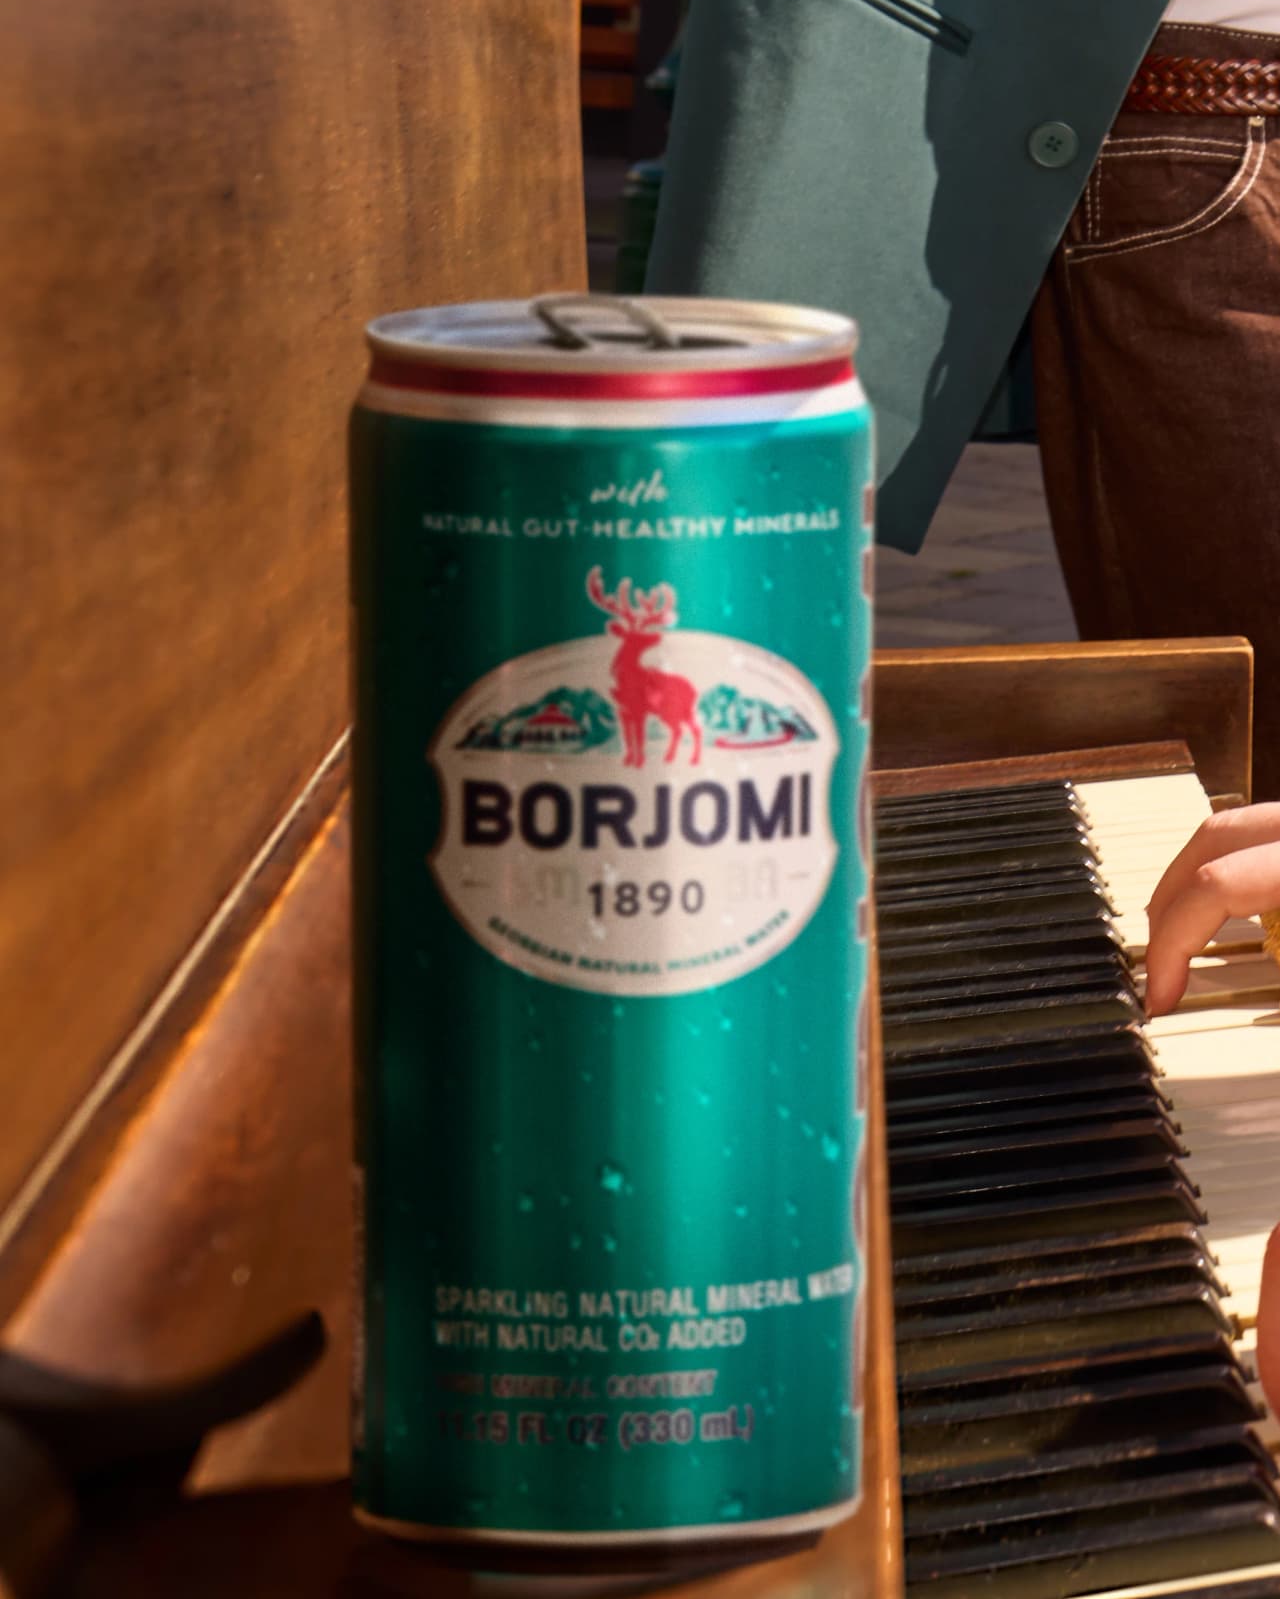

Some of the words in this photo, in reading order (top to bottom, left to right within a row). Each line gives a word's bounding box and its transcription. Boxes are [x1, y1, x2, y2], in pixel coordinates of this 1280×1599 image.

[589, 469, 669, 508] with
[422, 513, 513, 538] NATURAL
[733, 508, 841, 536] MINERALS
[461, 771, 812, 851] BORJOMI
[587, 878, 705, 919] 1890
[486, 914, 574, 967] GEORGIAN
[576, 955, 662, 975] NATURAL
[666, 945, 742, 972] MINERAL
[745, 909, 791, 949] WATER
[434, 1284, 569, 1319] SPARKLING
[578, 1286, 700, 1318] NATURAL
[705, 1276, 803, 1315] MINERAL
[434, 1318, 490, 1347] WITH
[496, 1323, 608, 1352] NATURAL
[666, 1315, 747, 1349] ADDED
[517, 1410, 554, 1446] FL
[566, 1411, 609, 1446] OZ
[617, 1406, 695, 1451] (330
